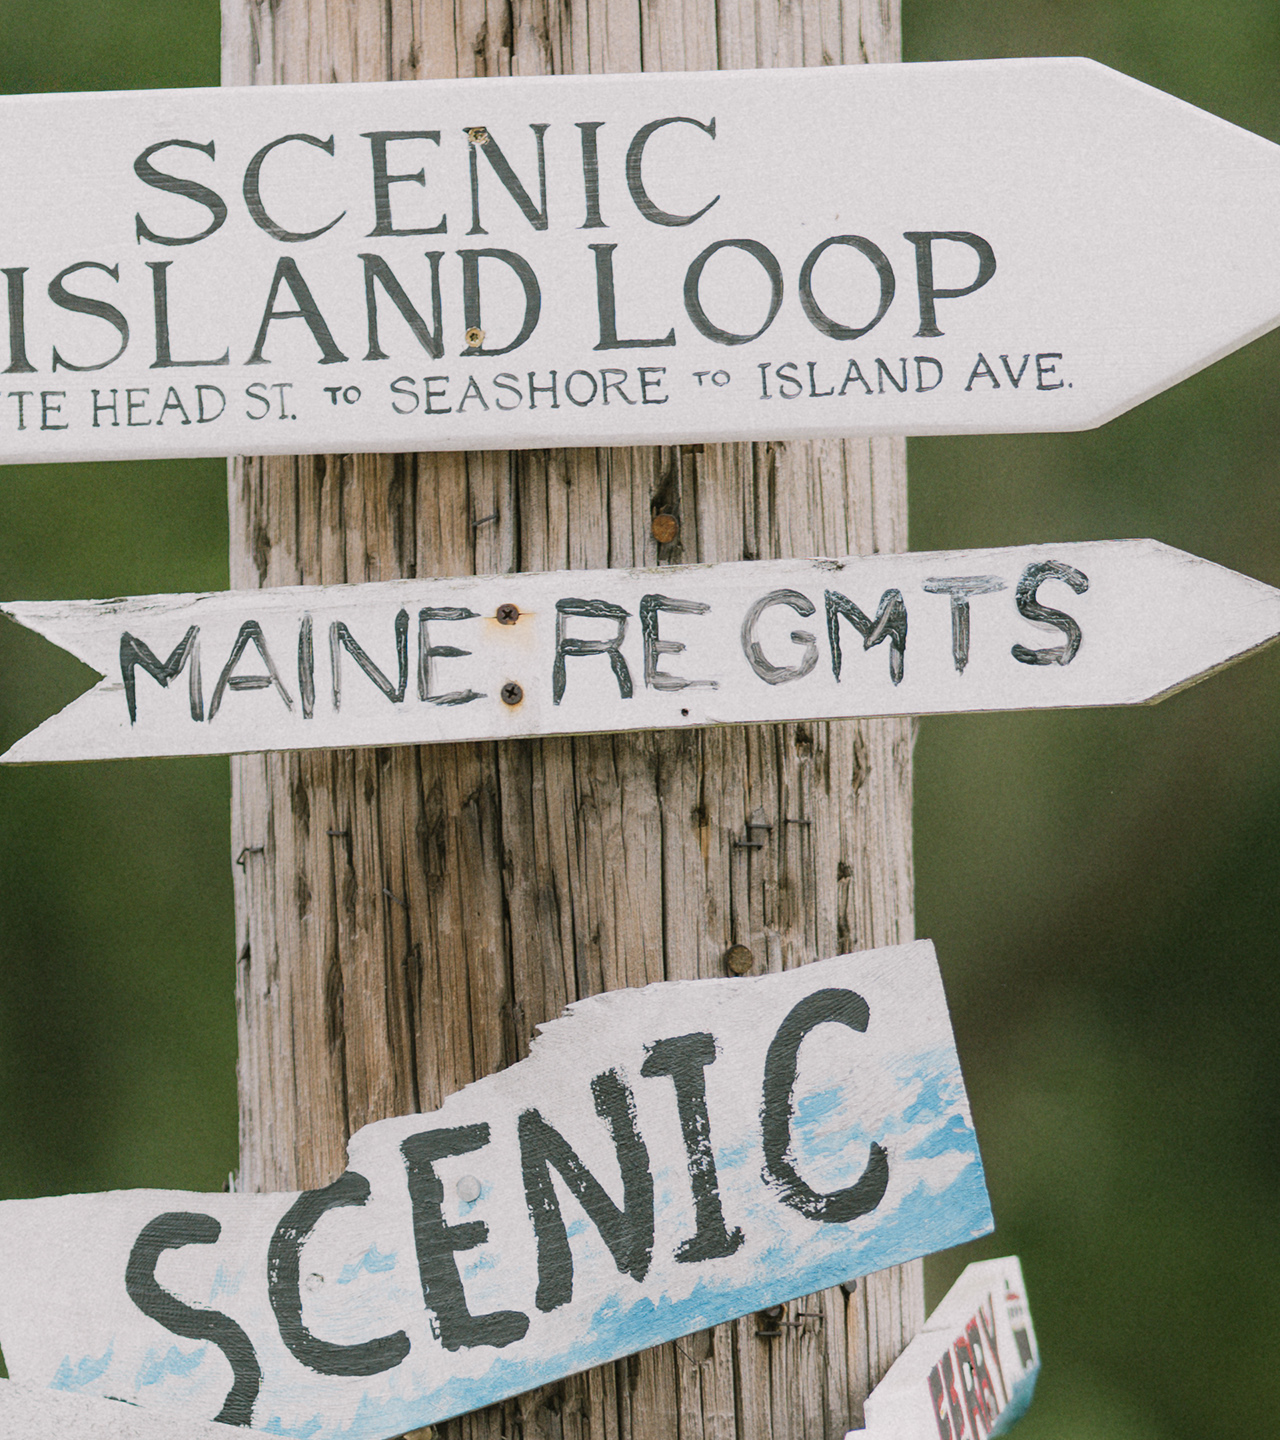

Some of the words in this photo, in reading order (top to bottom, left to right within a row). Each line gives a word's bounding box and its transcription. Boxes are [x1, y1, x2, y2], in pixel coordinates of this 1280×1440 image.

[132, 117, 721, 246] SCENIC
[0, 249, 542, 374] ISLAND
[588, 230, 997, 350] LOOP
[91, 384, 226, 428] HEAD
[245, 381, 298, 421] ST.
[323, 385, 362, 406] TO
[389, 366, 669, 416] SEASHORE
[691, 369, 731, 388] TO
[757, 354, 943, 400] ISLAND
[964, 351, 1075, 392] AVE.
[120, 607, 488, 726] MAINE
[125, 987, 889, 1427] SCENIC
